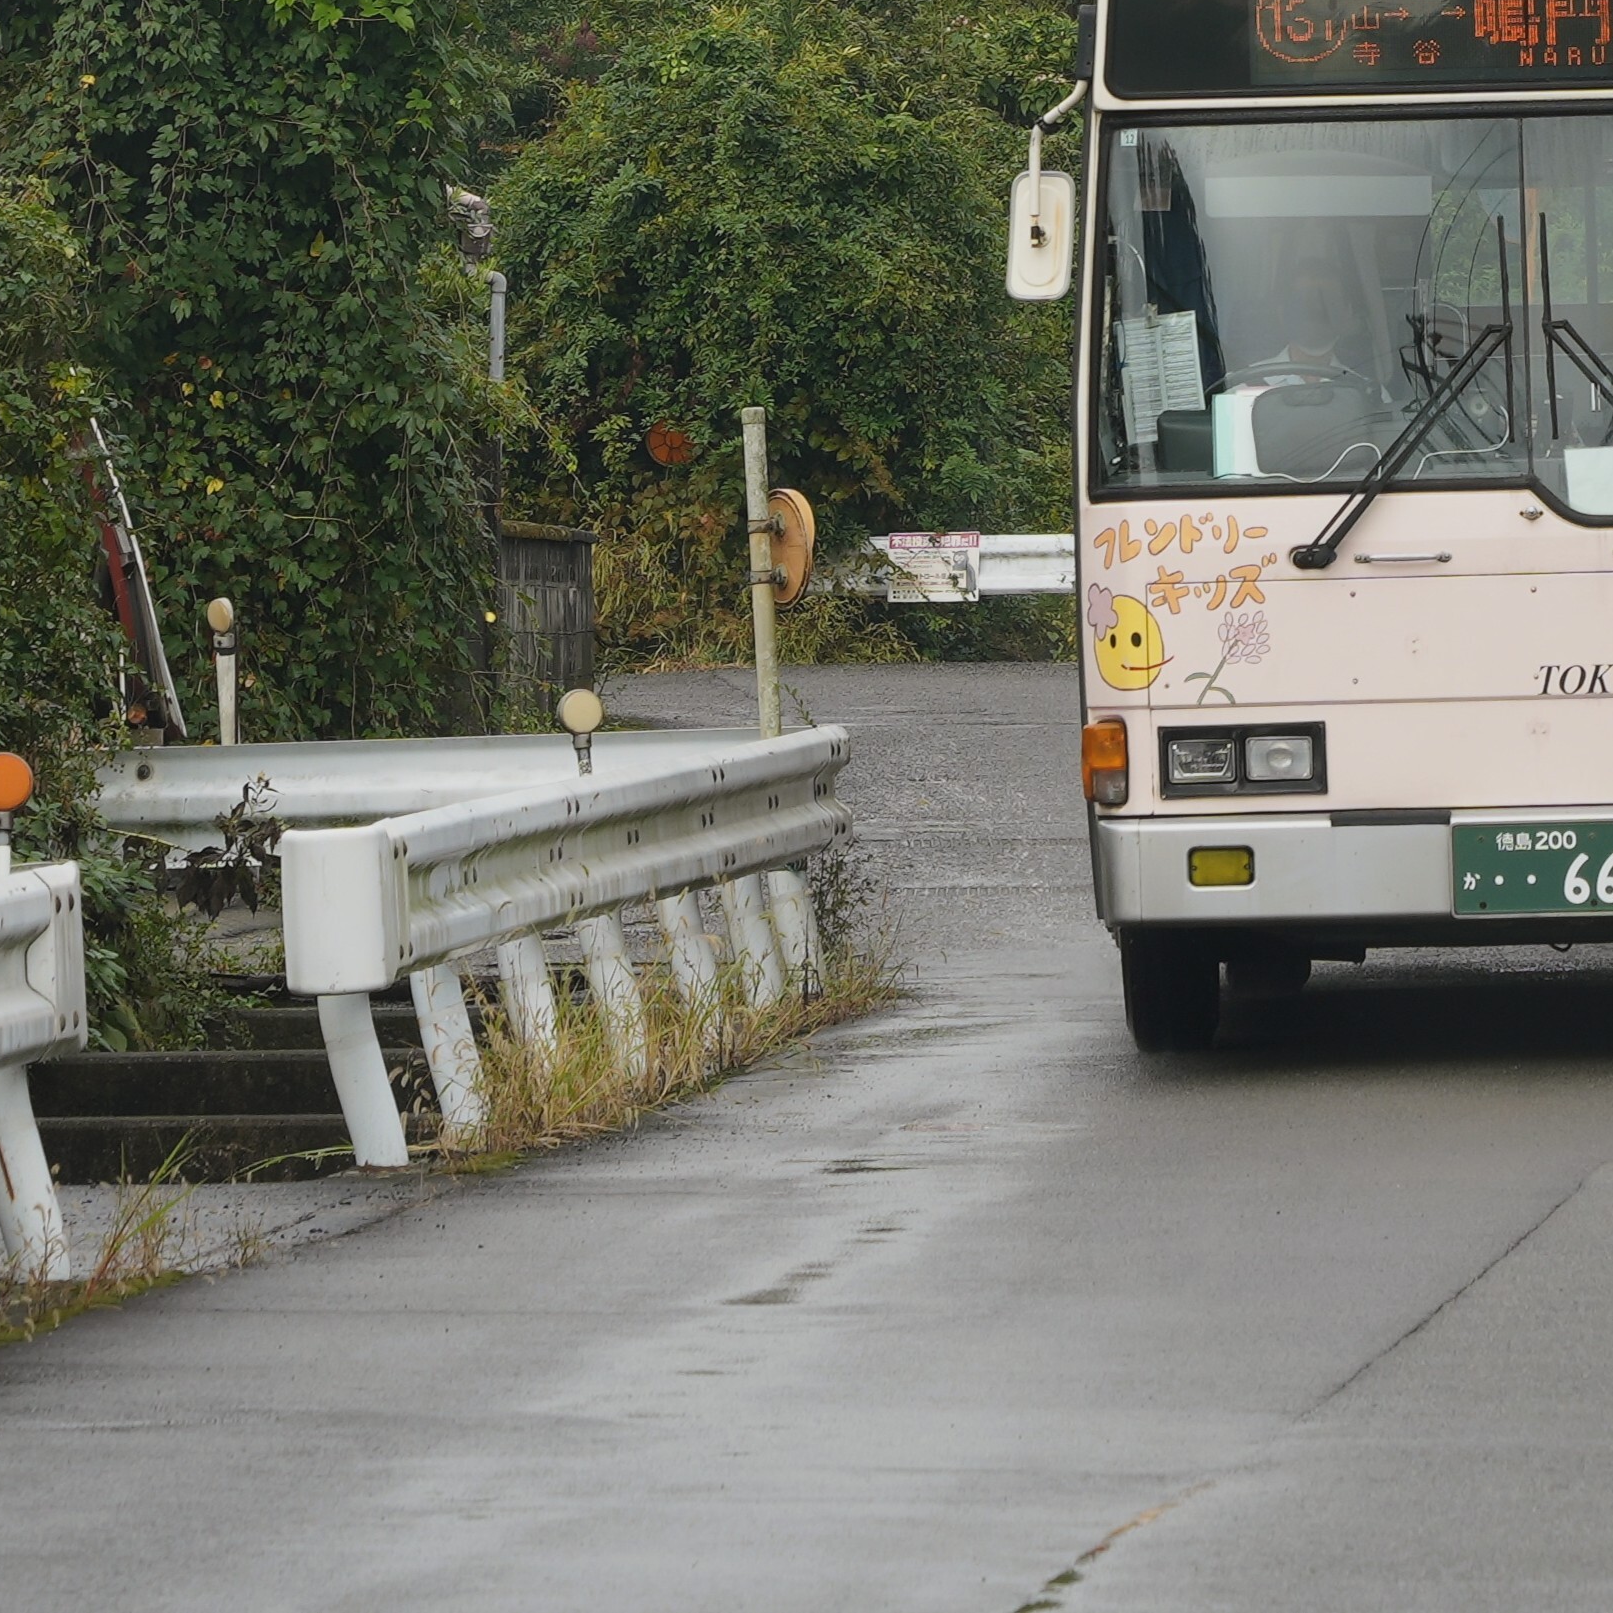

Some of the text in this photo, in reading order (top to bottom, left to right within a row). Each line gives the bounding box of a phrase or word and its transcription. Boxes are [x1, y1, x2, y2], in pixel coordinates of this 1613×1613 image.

[1094, 512, 1269, 570] フレンドリー
[1149, 552, 1277, 615] キッズ
